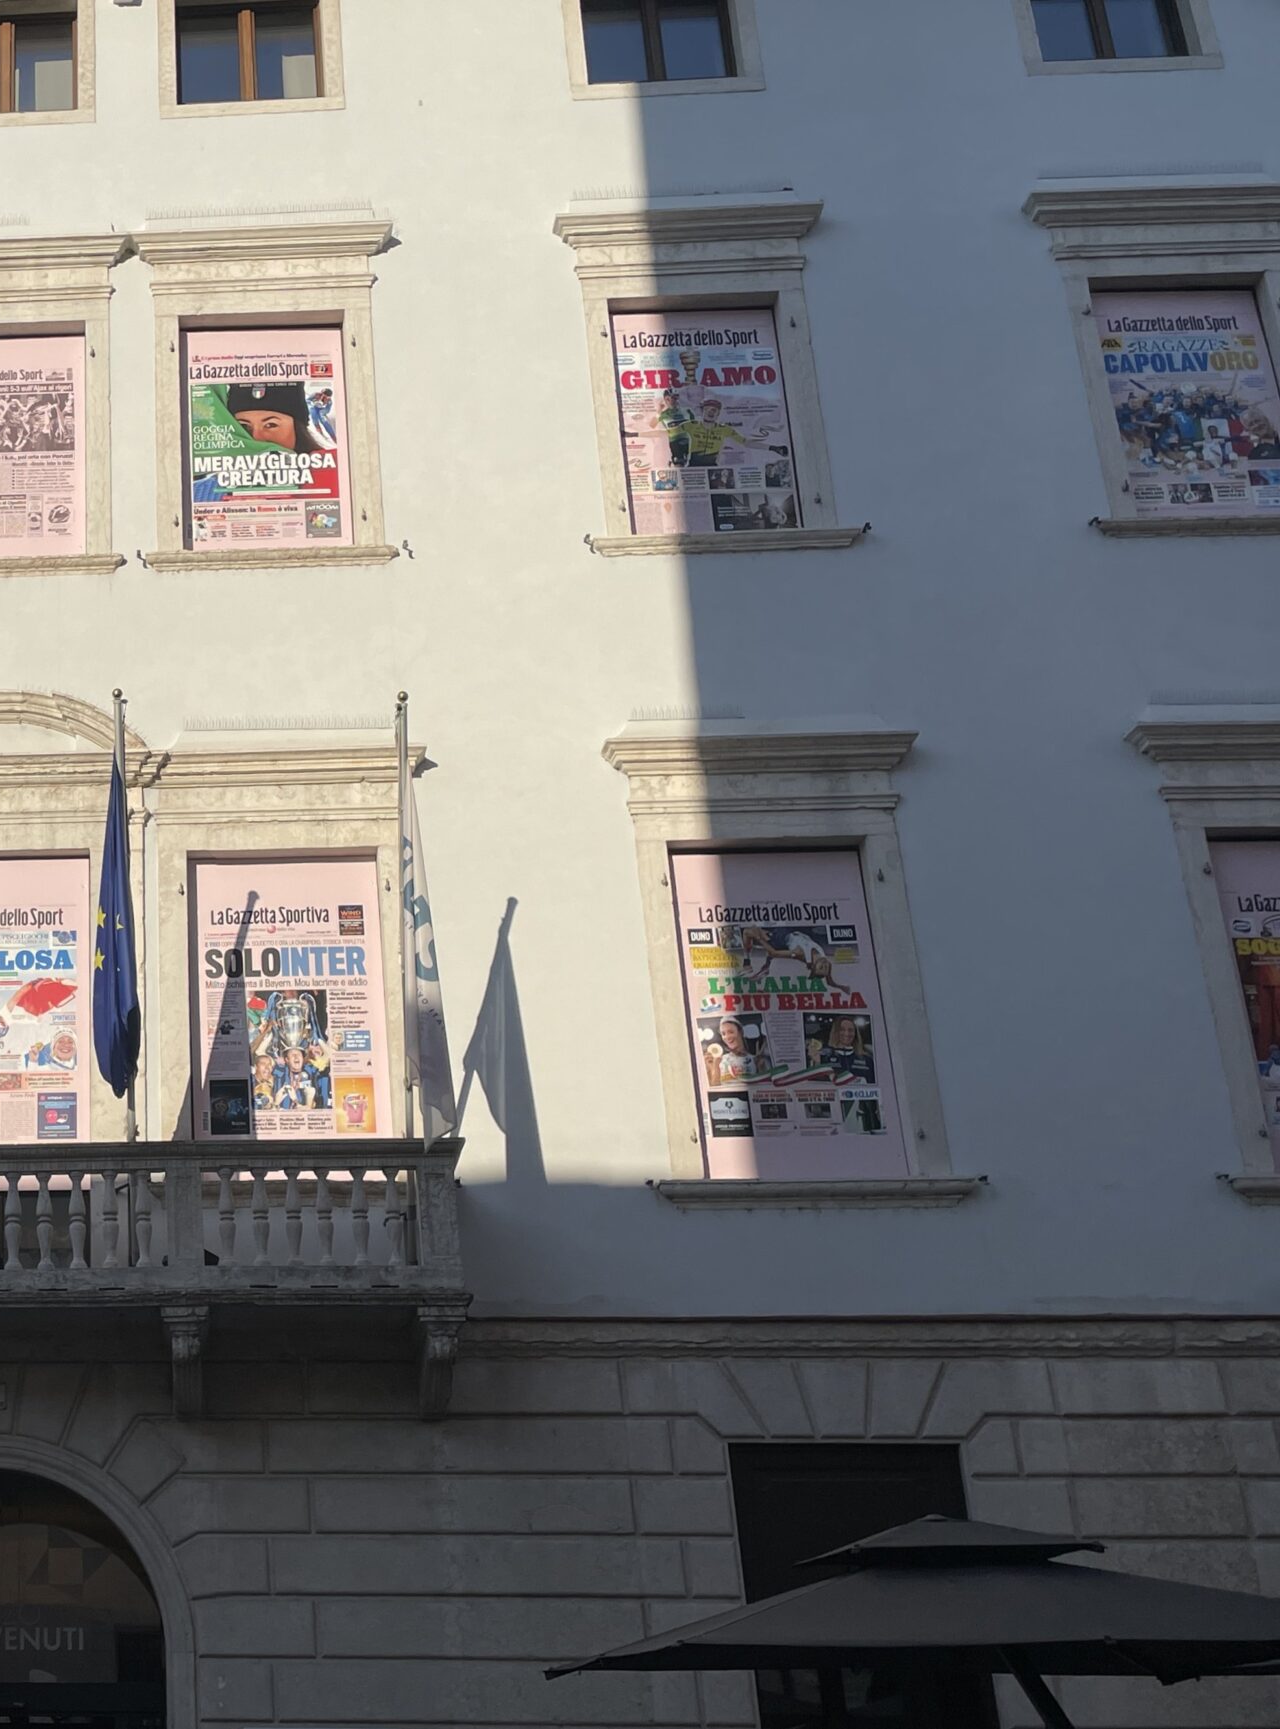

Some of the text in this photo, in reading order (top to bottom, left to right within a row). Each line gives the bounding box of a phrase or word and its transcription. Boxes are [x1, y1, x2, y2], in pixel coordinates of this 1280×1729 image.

[1108, 315, 1238, 332] La Gazzetta dello Sport
[623, 329, 760, 348] La Gazzetta dello Sport
[1137, 338, 1218, 352] RAGAZZE
[190, 362, 309, 379] La Gazzetta dello Sport
[1103, 351, 1259, 374] CAPOLAVORO
[0, 370, 18, 381] dello
[20, 369, 43, 381] Sport
[193, 425, 235, 434] GOGGIA
[193, 433, 234, 442] REGINA
[193, 440, 245, 449] OLIMPICA
[194, 453, 336, 473] MERAVIGLIOSA
[217, 469, 314, 487] CREATURA
[699, 902, 840, 923] La Gazzetta dello Sport
[1238, 896, 1254, 912] La
[0, 908, 28, 926] dello
[30, 908, 64, 928] Sport
[211, 906, 330, 926] La Gazzetta Sportiva
[707, 976, 828, 994] L'ITALIA
[724, 990, 867, 1012] PIÙ BELLA
